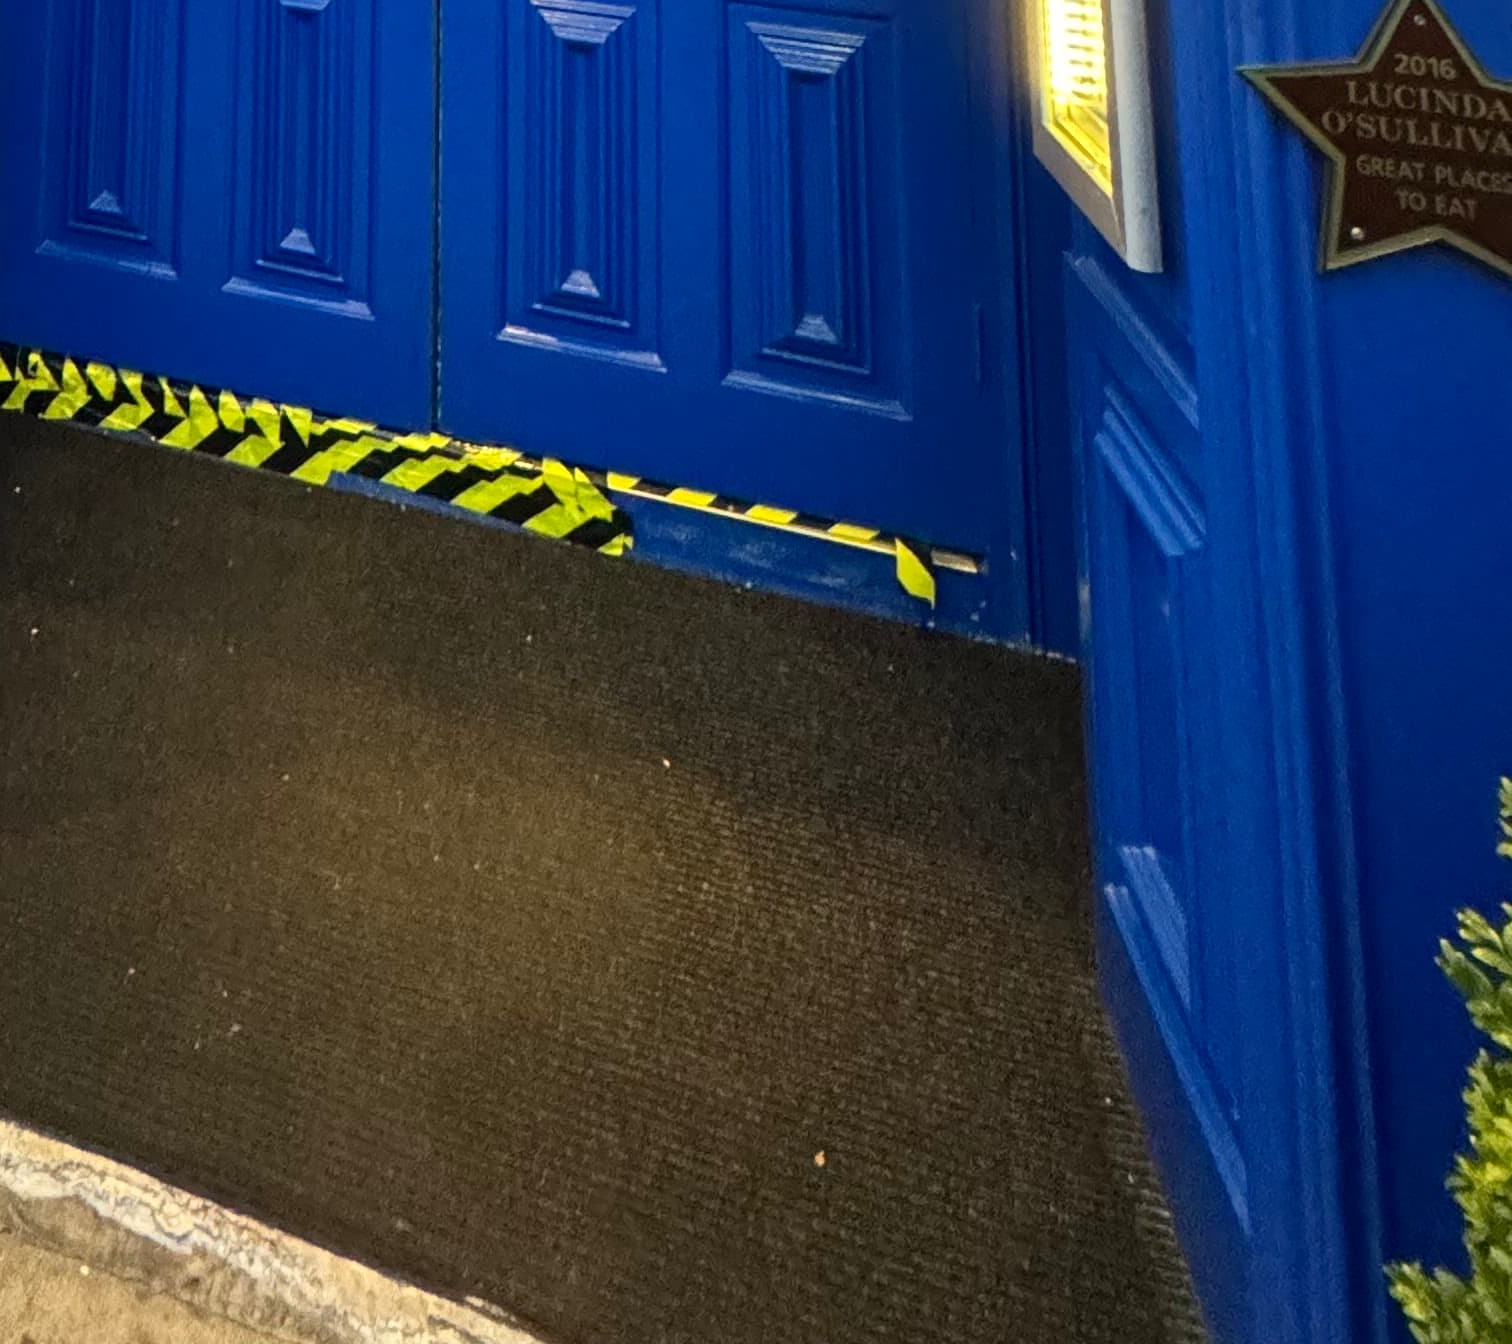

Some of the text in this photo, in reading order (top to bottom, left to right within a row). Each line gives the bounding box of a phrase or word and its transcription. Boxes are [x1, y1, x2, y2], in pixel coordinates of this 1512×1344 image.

[1393, 53, 1457, 81] 2016
[1345, 80, 1512, 123] LUCINDA
[1320, 108, 1512, 157] O'SULLIVA
[1355, 153, 1427, 181] GREAT
[1396, 189, 1479, 221] TO EAT
